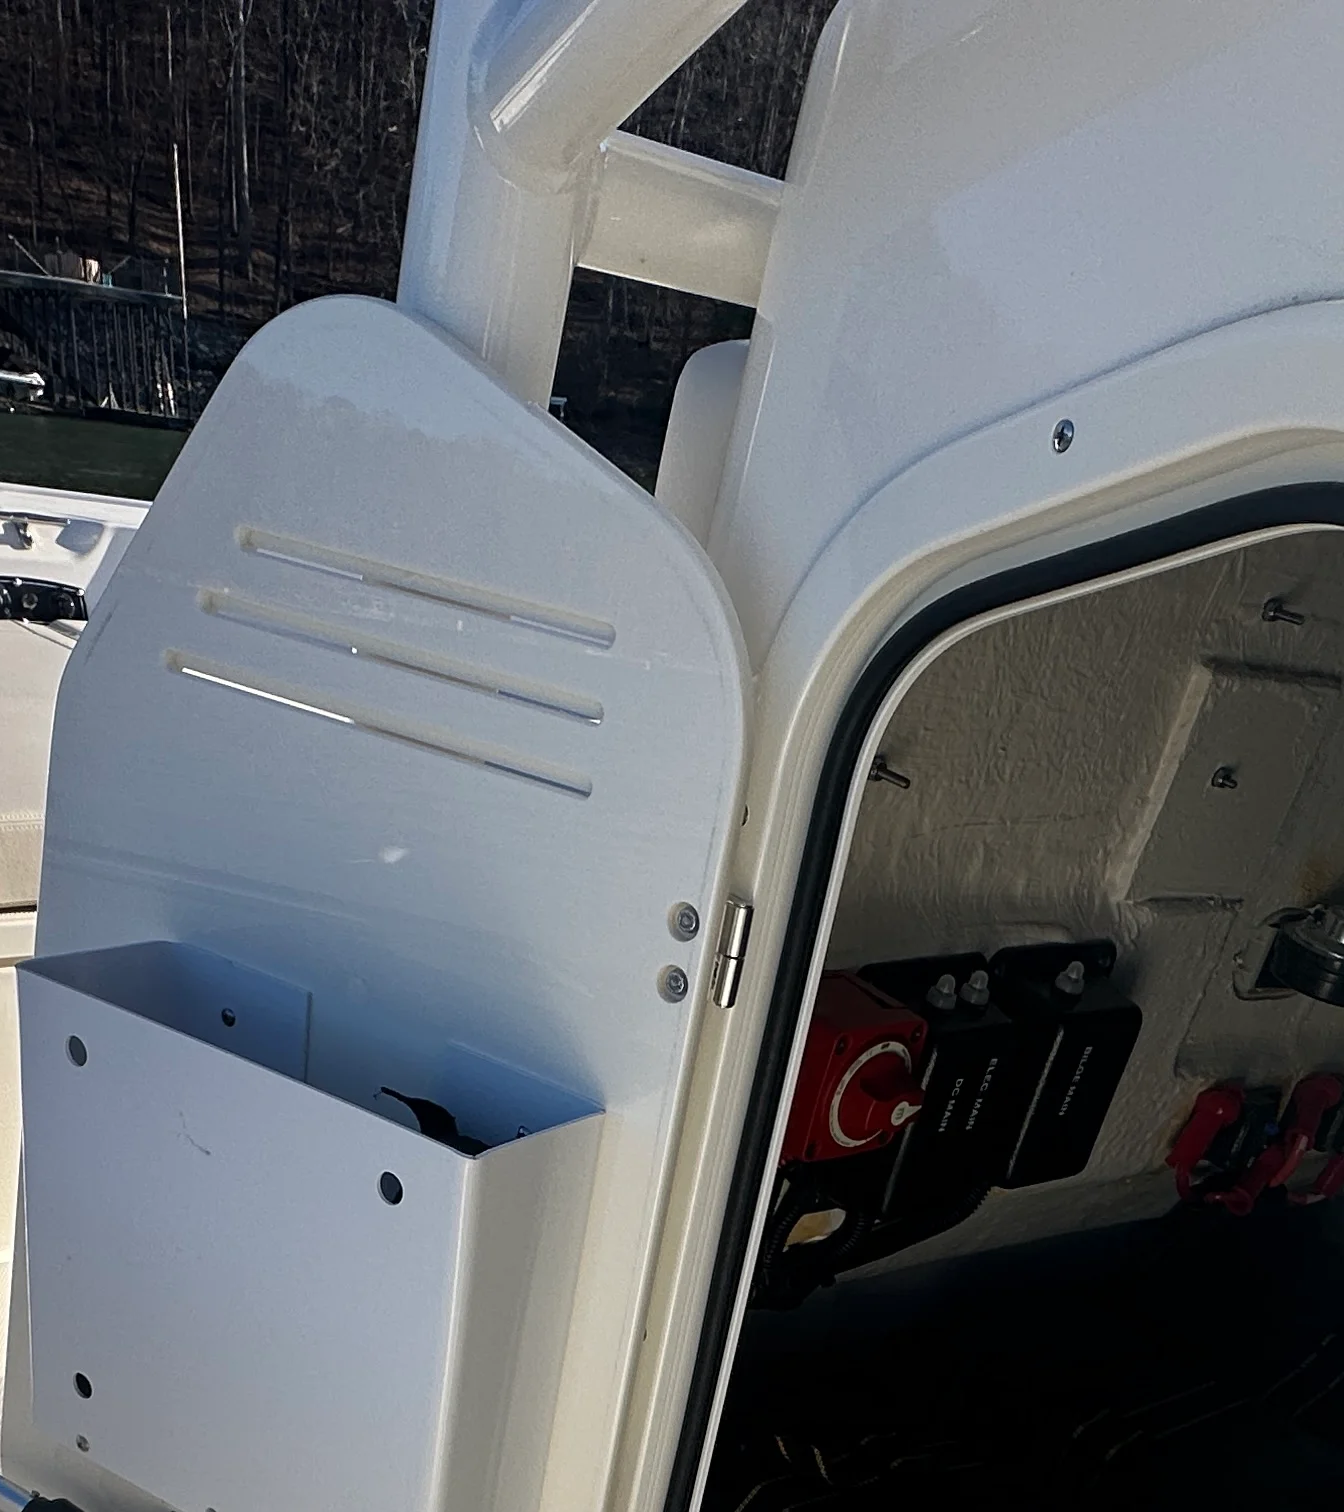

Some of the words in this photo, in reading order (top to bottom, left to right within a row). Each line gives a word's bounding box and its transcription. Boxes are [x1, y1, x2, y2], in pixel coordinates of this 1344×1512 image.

[951, 1078, 964, 1097] DC
[1058, 1085, 1076, 1116] MAIN
[937, 1100, 955, 1132] MAIN
[965, 1098, 983, 1131] MAIN
